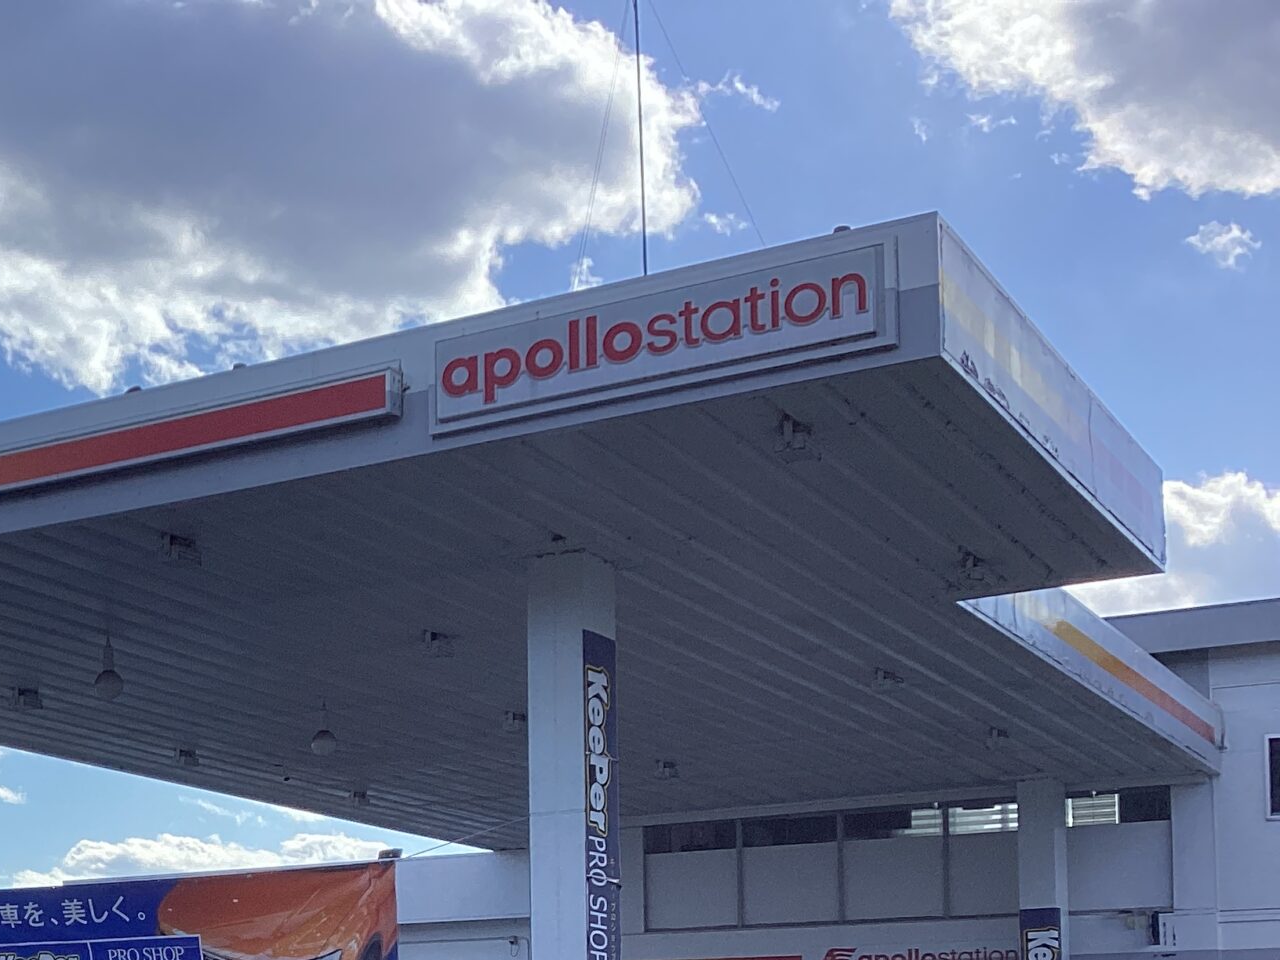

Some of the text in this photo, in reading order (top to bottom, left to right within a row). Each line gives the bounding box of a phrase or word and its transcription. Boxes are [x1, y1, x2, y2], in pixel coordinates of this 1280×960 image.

[441, 272, 869, 404] apollostation
[586, 666, 609, 837] KeePer
[589, 836, 608, 887] PRO
